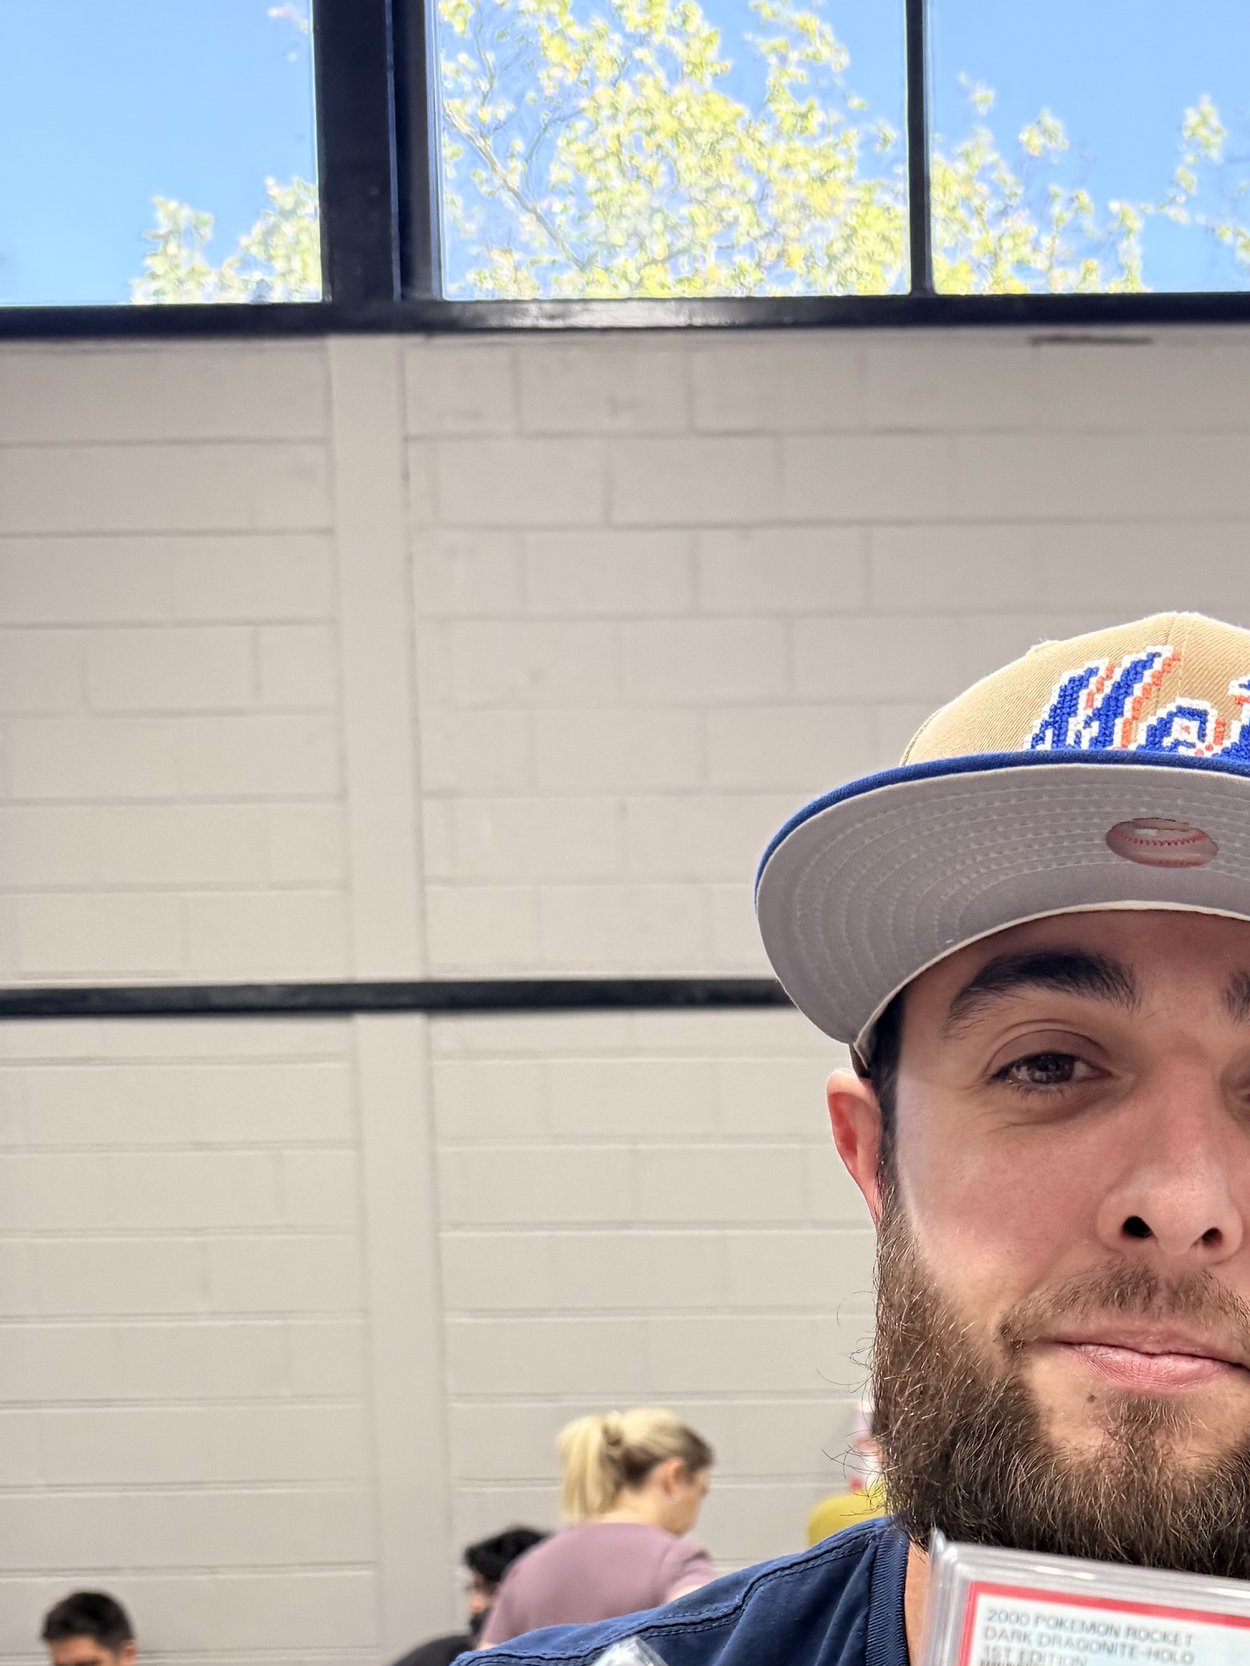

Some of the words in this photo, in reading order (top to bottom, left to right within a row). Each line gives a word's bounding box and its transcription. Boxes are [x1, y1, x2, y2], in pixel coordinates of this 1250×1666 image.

[983, 1627, 1031, 1644] DARK
[1040, 1634, 1193, 1665] DRAGONITE-HOLO
[987, 1609, 1029, 1625] 2000
[1034, 1615, 1120, 1636] POKEMON
[1126, 1627, 1192, 1646] ROCKET
[983, 1645, 1011, 1660] 1ST
